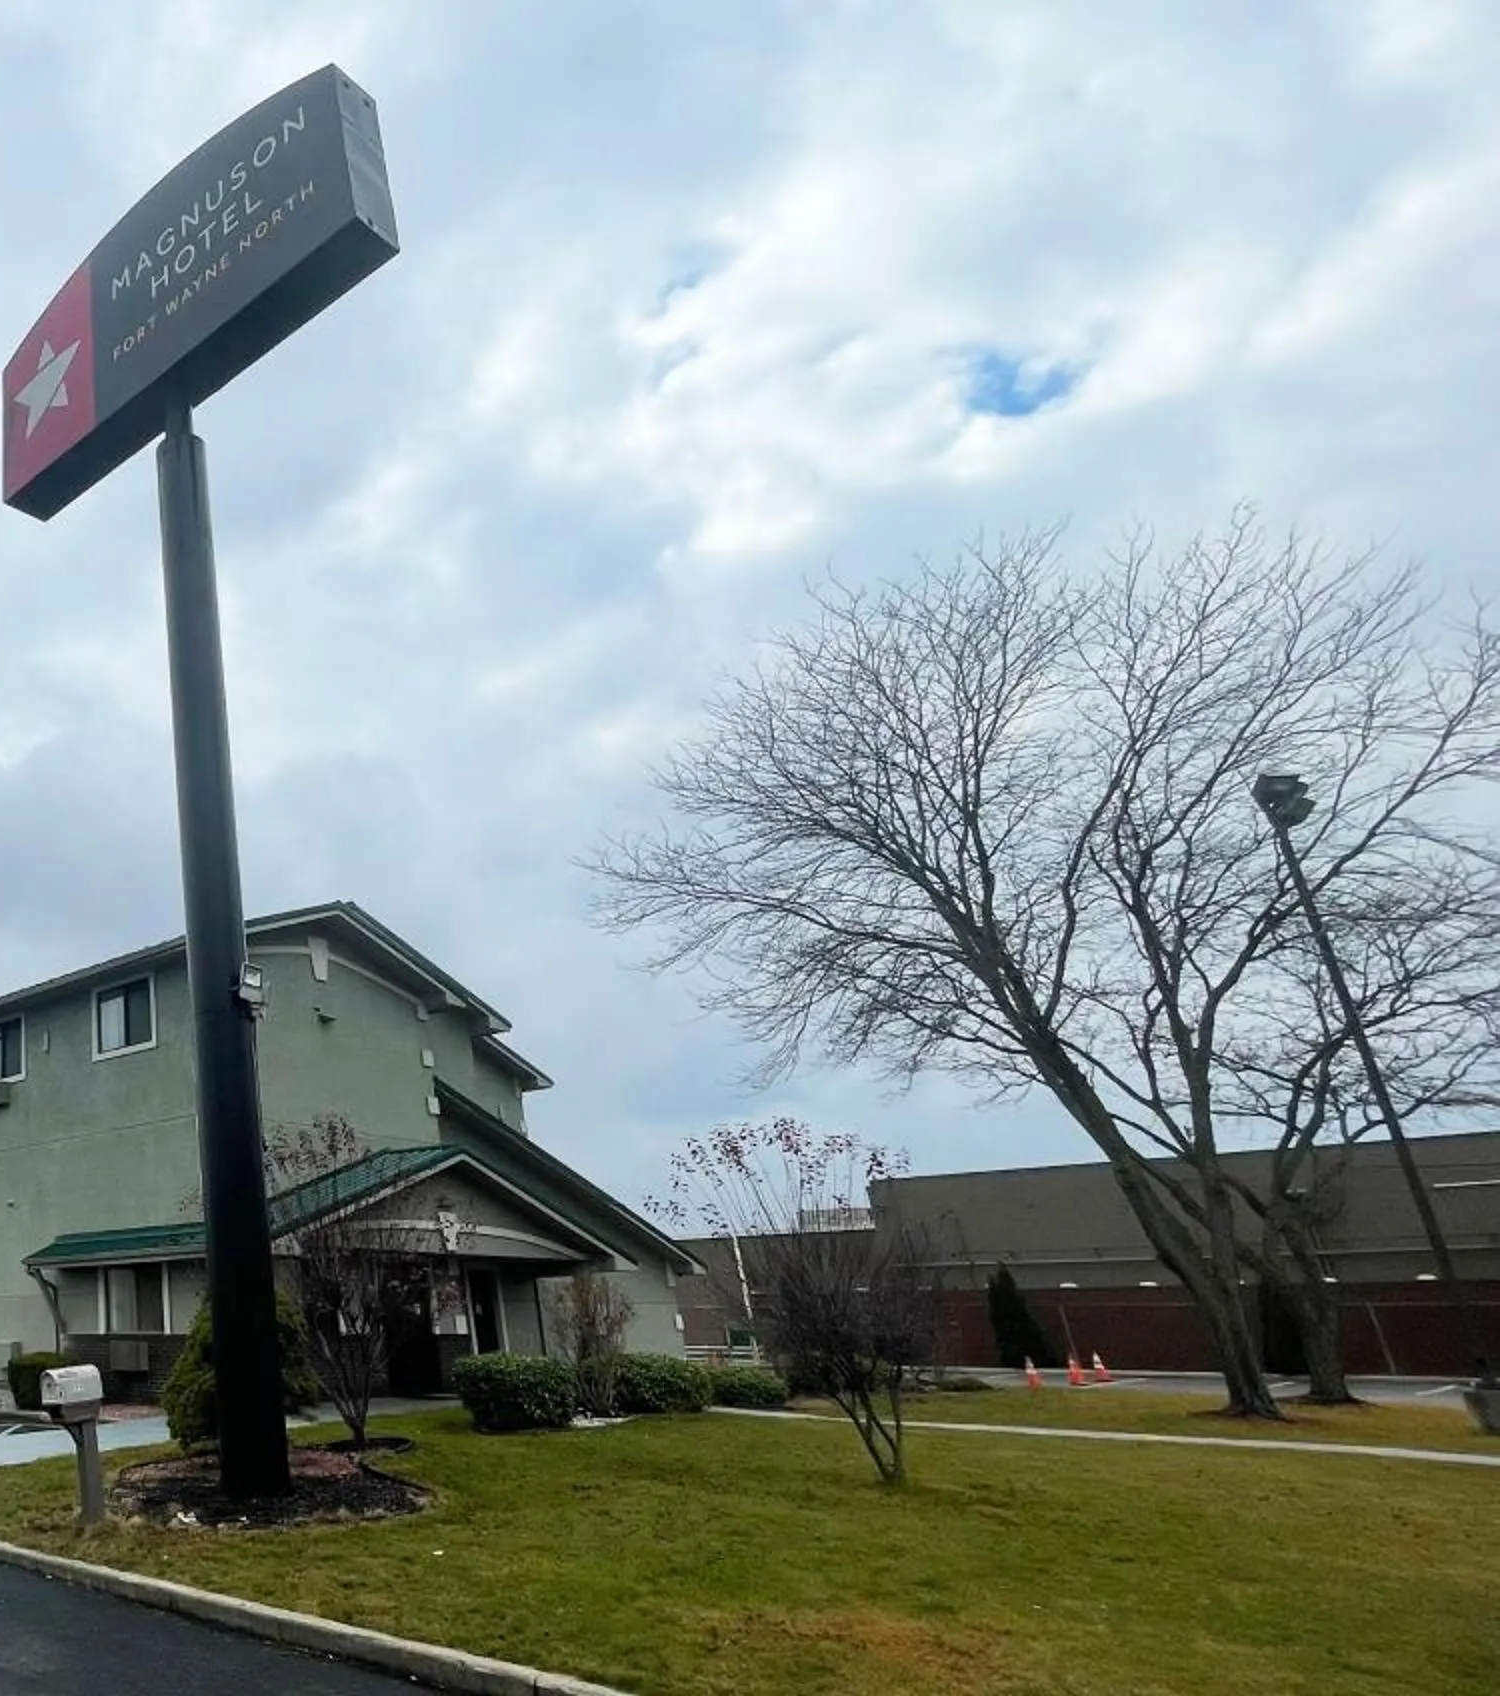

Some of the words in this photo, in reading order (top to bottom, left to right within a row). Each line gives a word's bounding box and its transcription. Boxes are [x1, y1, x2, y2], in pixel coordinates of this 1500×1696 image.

[112, 106, 306, 300] MAGNUSON
[112, 315, 159, 361] FORT
[165, 254, 230, 315] WAYNE
[239, 180, 315, 250] NORTH
[150, 191, 262, 299] HOTEL
